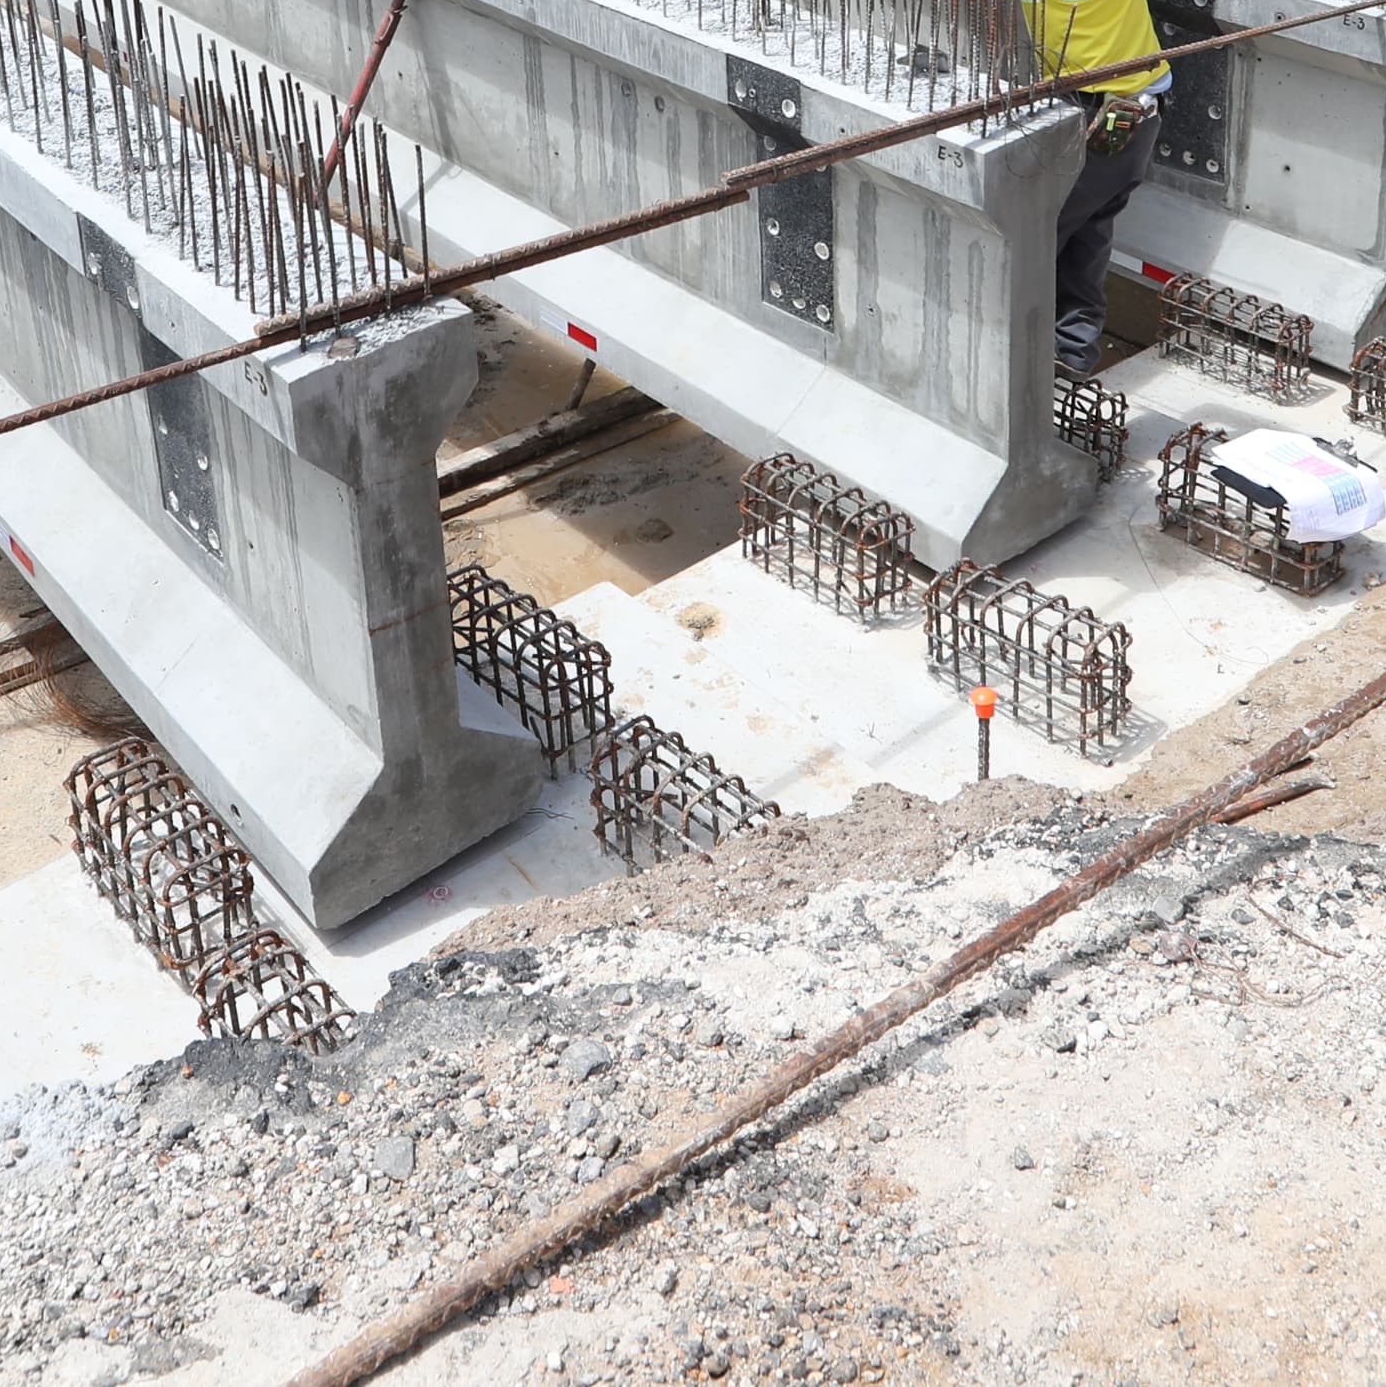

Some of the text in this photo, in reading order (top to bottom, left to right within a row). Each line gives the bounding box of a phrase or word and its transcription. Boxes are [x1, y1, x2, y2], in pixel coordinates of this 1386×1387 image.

[1343, 14, 1365, 30] E-3
[937, 145, 964, 168] E-3
[244, 361, 268, 397] E-3
